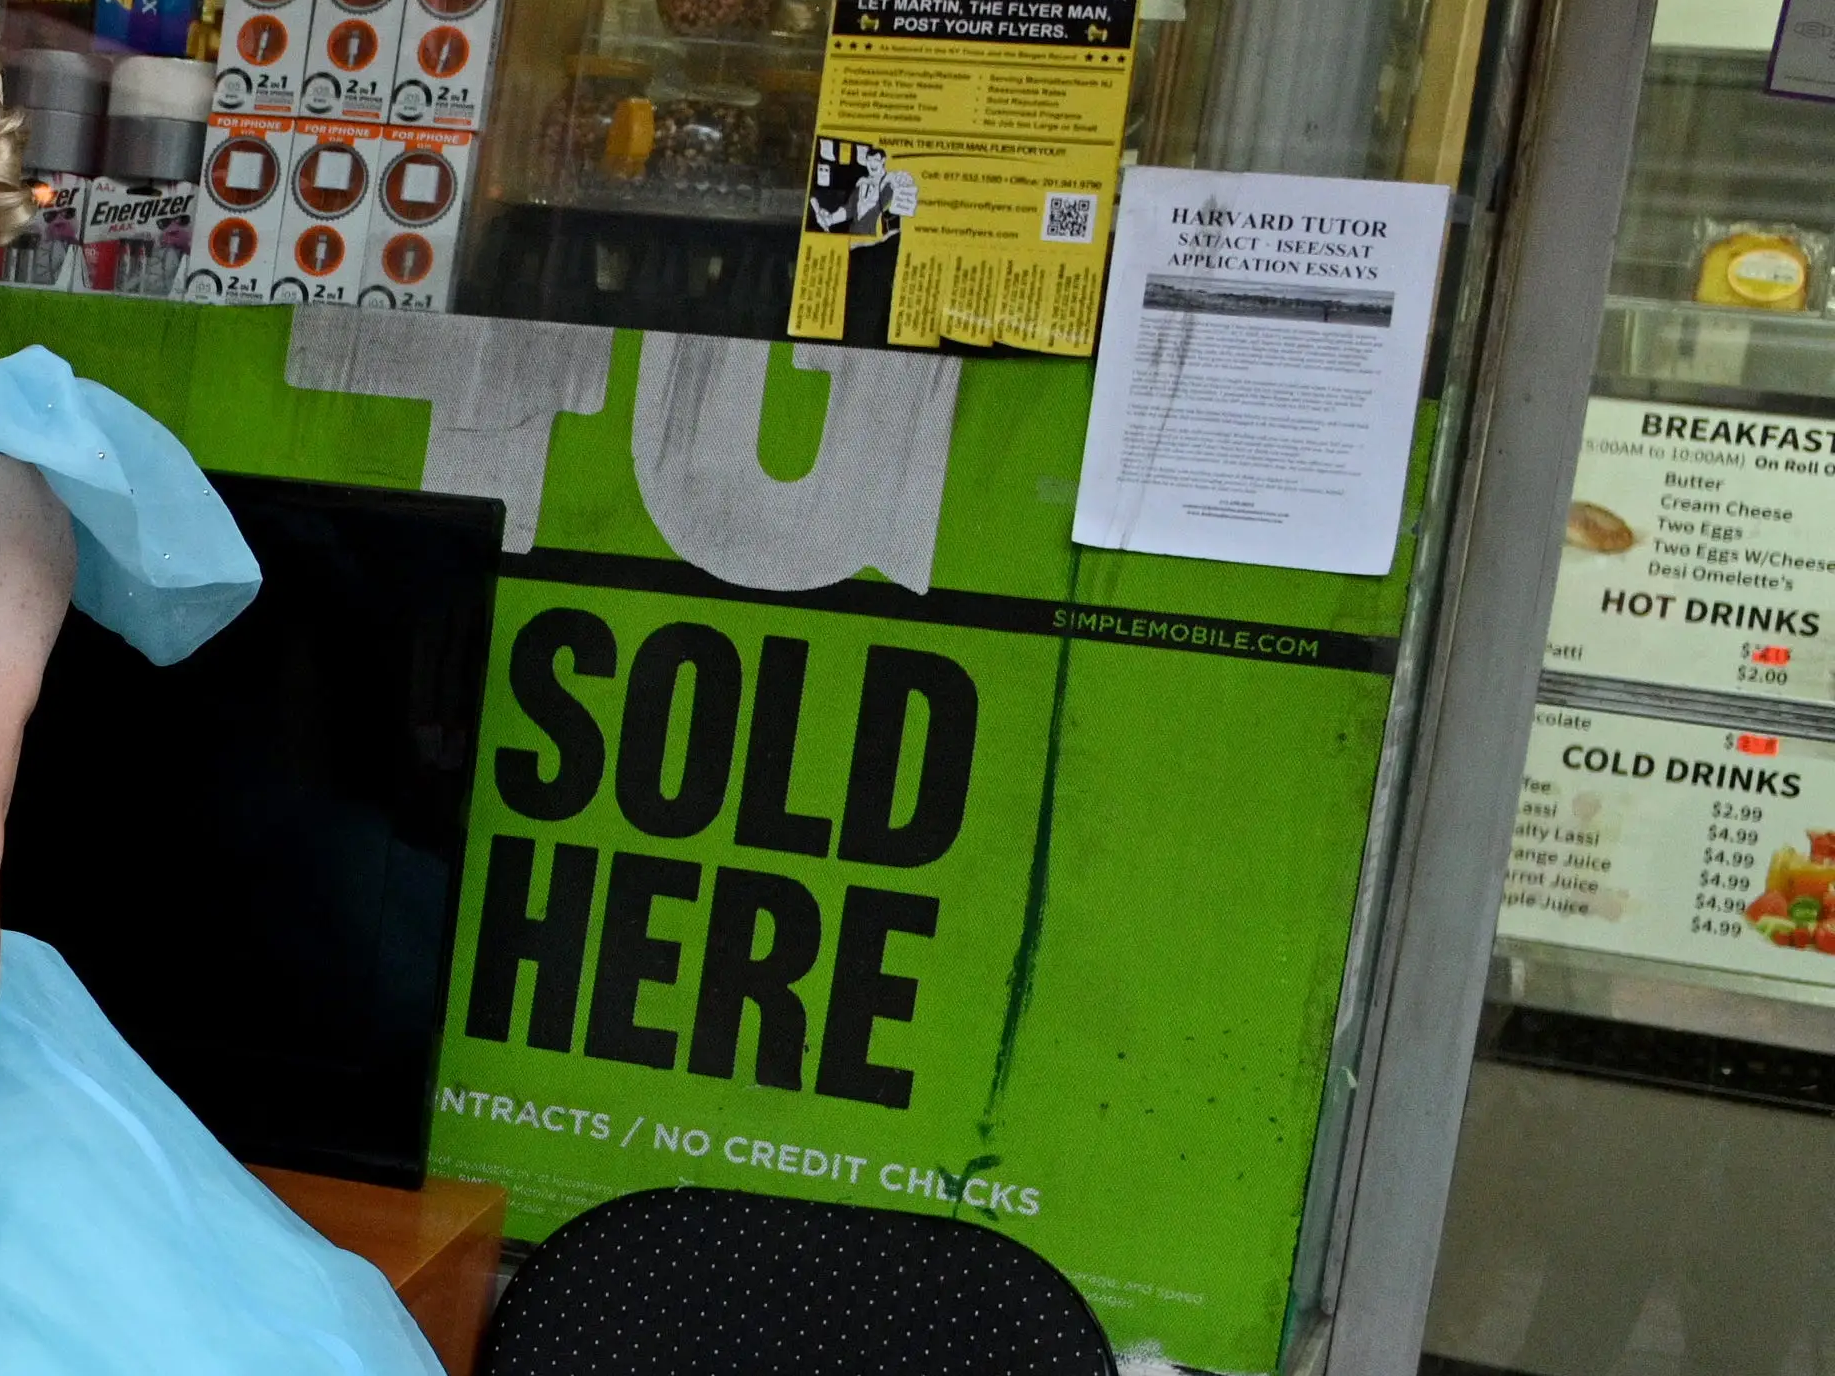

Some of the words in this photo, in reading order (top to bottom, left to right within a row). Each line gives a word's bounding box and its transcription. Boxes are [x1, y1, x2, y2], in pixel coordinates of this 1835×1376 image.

[969, 0, 1003, 16] THE
[1008, 3, 1064, 19] FLYER
[1068, 5, 1112, 22] MAN,
[893, 16, 940, 33] POST
[944, 19, 994, 35] YOUR
[998, 21, 1069, 39] FLYERS.
[257, 74, 269, 88] 2
[216, 117, 238, 129] FOR
[238, 118, 283, 131] iPHONE
[304, 124, 327, 136] FOR
[326, 125, 372, 138] iPHONE
[391, 130, 416, 142] FOR
[415, 131, 461, 145] iPHONE
[90, 194, 195, 226] Energizer
[1171, 207, 1294, 232] HARVARD
[1301, 215, 1389, 238] TUTOR
[1177, 231, 1261, 252] SAT/ACT
[1274, 238, 1374, 260] ISEE/SSAT
[1167, 252, 1301, 275] APPLICATION
[1305, 261, 1379, 281] ESSAYS
[1648, 448, 1666, 460] to
[1755, 455, 1779, 471] On
[1784, 458, 1819, 476] Roll
[1664, 471, 1725, 492] Butter
[1660, 493, 1721, 515] Cream
[1726, 500, 1794, 522] Cheese
[1658, 515, 1695, 534] Two
[1700, 520, 1744, 543] Eggs
[1653, 538, 1691, 557] Two
[1696, 544, 1739, 566] Eggs
[1744, 548, 1835, 574] W/Cheese
[1647, 560, 1687, 578] Desi
[1692, 565, 1794, 592] Omelette's
[1601, 589, 1677, 620] HOT
[1684, 598, 1821, 639] DRINKS
[1052, 608, 1320, 659] SIMPLEMOBILE.COM
[1737, 664, 1789, 686] $2.00
[492, 605, 980, 870] SOLD
[1561, 743, 1656, 778] COLD
[1665, 756, 1803, 799] DRINKS
[1712, 800, 1763, 822] $2.99
[1554, 826, 1601, 849] Lassi
[1708, 824, 1759, 846] $4.99
[1563, 852, 1612, 873] Juice
[1704, 847, 1755, 869] $4.99
[1550, 873, 1599, 894] Juice
[1700, 869, 1751, 892] $4.99
[1539, 894, 1589, 917] Juice
[1695, 892, 1747, 915] $4.99
[1691, 915, 1743, 939] $4.99
[462, 832, 940, 1111] HERE
[433, 1084, 613, 1141] NTRACTS
[652, 1122, 714, 1158] NO
[722, 1134, 869, 1185] CREDIT
[877, 1163, 1044, 1218] CHECKS
